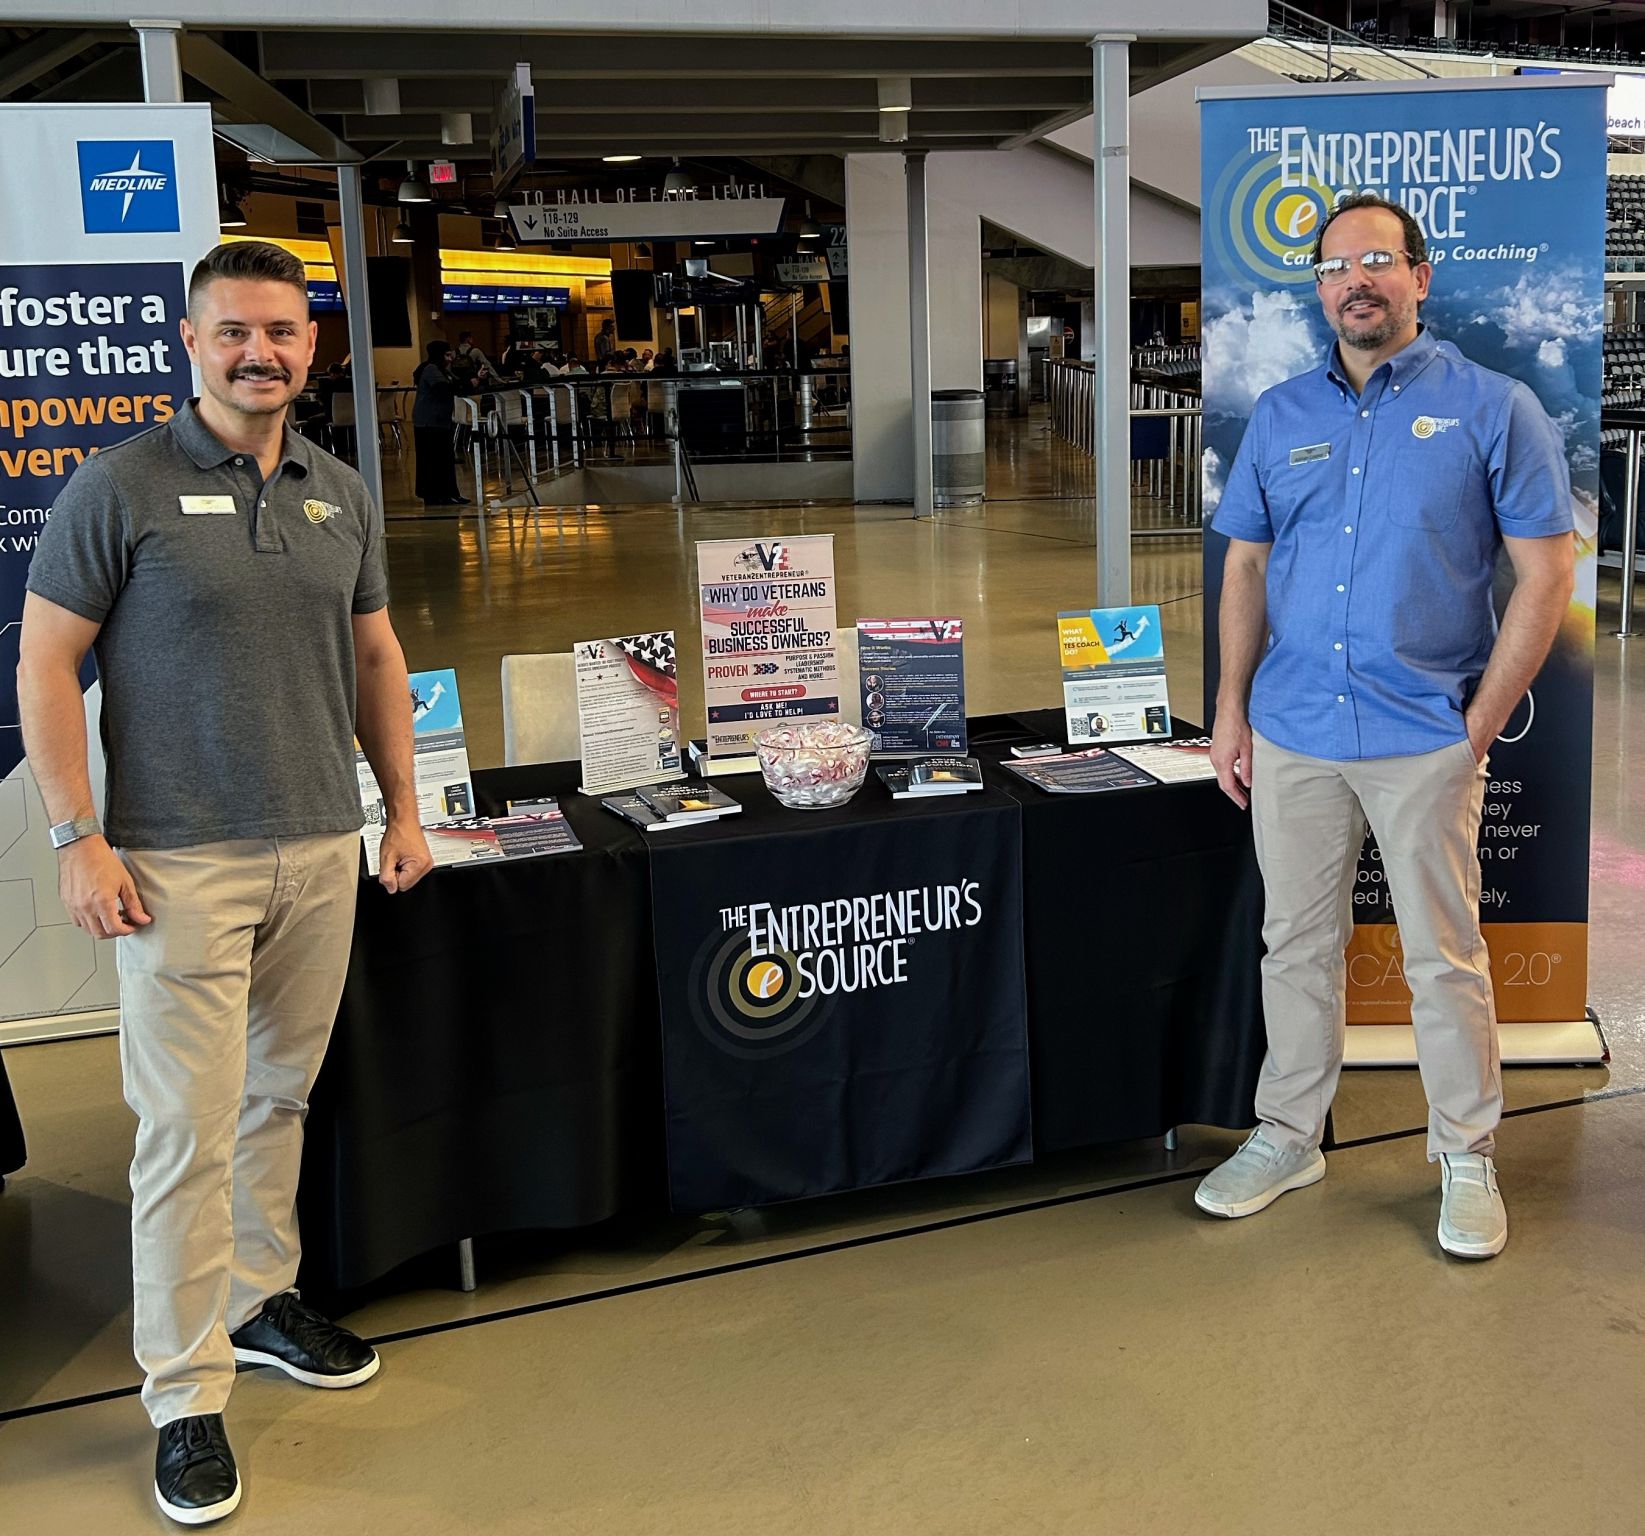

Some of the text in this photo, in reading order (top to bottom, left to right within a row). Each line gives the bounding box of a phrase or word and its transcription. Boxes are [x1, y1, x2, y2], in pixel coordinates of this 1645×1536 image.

[1247, 121, 1562, 187] THE ENTREPRENEUR'S
[90, 177, 166, 191] MEDLINE
[522, 184, 767, 206] TO HALL OF FAME LEVEL
[543, 212, 578, 224] 118-129
[544, 226, 608, 238] No Suite Access
[0, 287, 166, 327] foster a
[78, 336, 171, 375] that
[710, 582, 826, 603] WHY DO VETERANS
[747, 600, 788, 618] make
[730, 617, 808, 636] SUCCESSFUL
[709, 631, 830, 654] BUSINESS OWNERS?
[708, 665, 748, 678] PROVEN
[778, 688, 798, 697] START?
[755, 710, 772, 718] LOVE
[1485, 824, 1541, 838] never
[1498, 847, 1519, 860] or
[719, 879, 982, 957] THE ENTREPRENEUR'S
